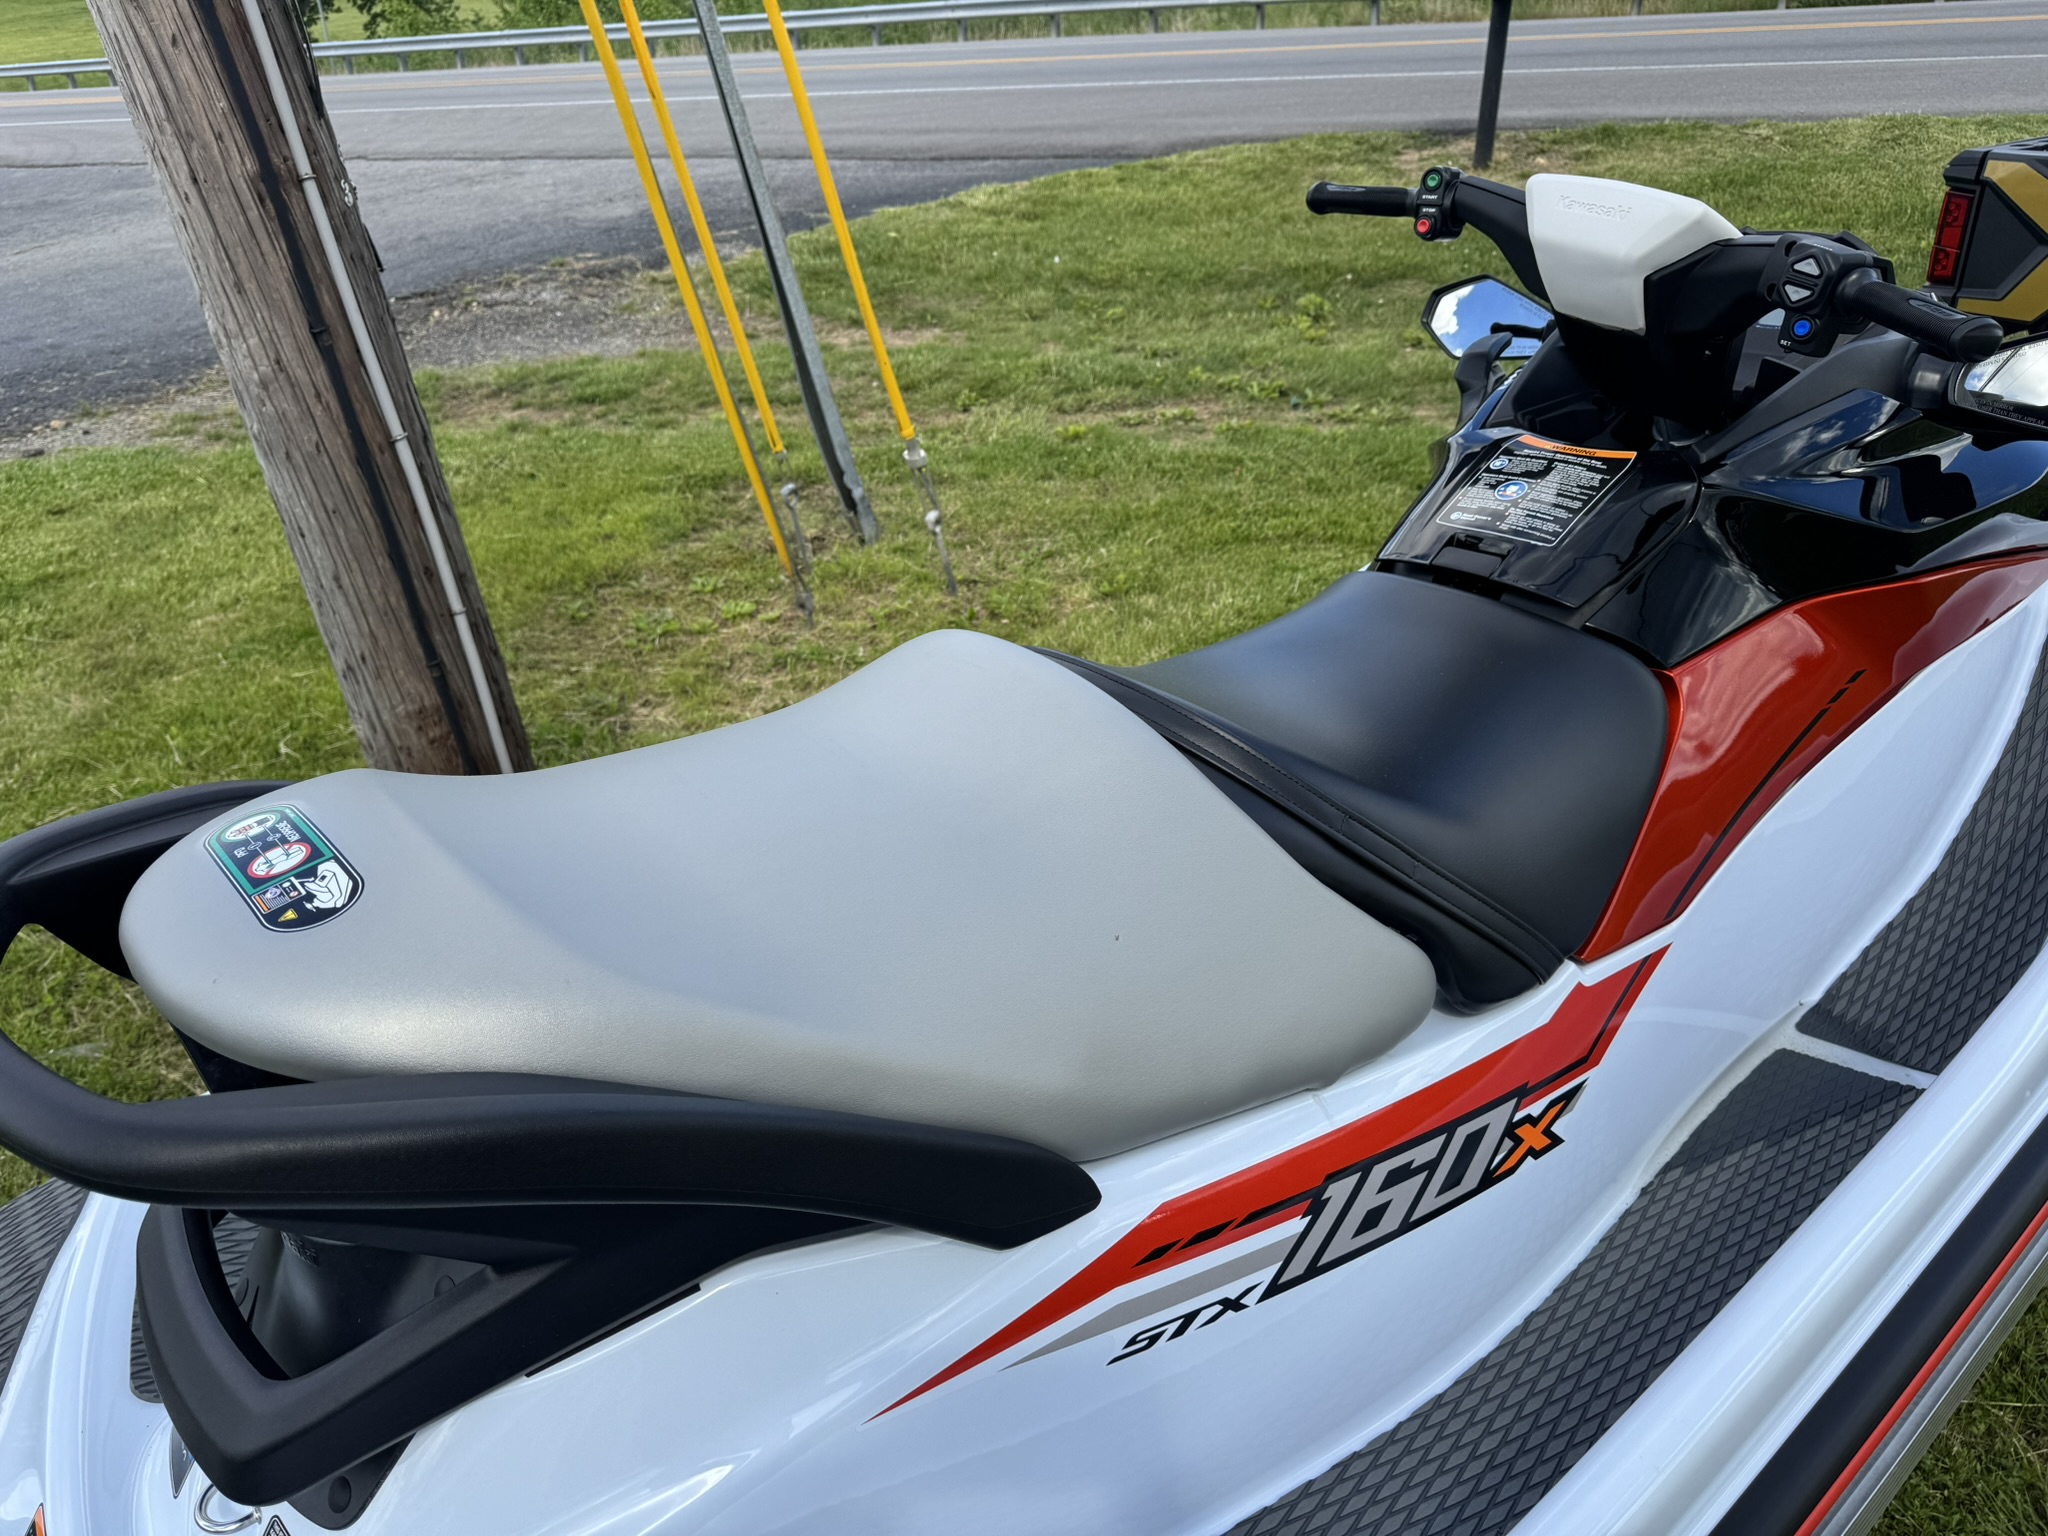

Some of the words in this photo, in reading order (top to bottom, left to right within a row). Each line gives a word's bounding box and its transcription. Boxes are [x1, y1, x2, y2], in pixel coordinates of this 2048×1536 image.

[1557, 195, 1632, 221] Kawasaki
[1552, 445, 1597, 456] WARNING
[1106, 1280, 1264, 1366] STX
